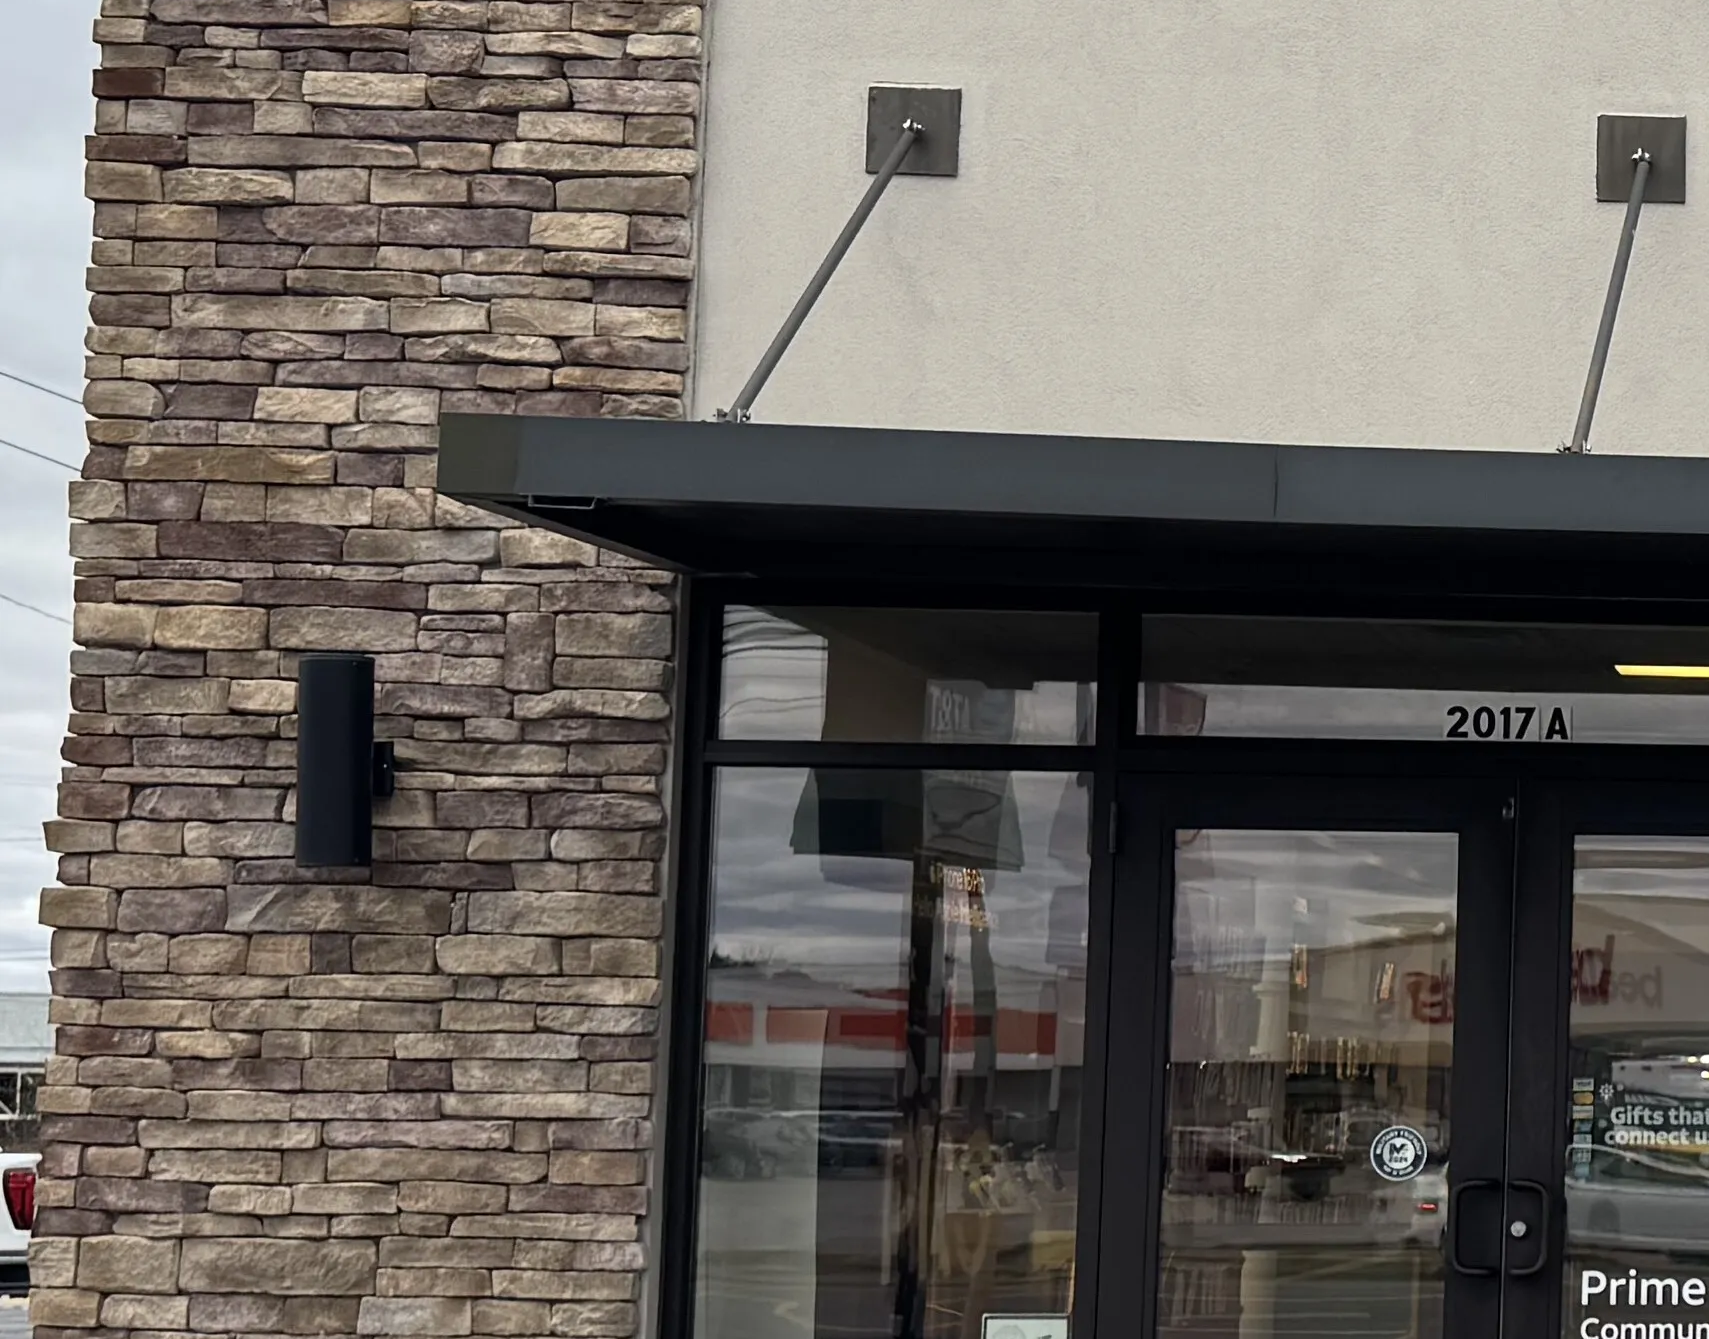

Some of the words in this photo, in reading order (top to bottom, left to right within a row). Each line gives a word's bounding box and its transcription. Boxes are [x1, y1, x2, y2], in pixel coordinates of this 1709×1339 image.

[1446, 705, 1537, 740] 2017
[1545, 707, 1569, 740] A
[1610, 1106, 1664, 1126] Gifts
[1604, 1127, 1689, 1146] connect
[1581, 1269, 1706, 1306] Prime
